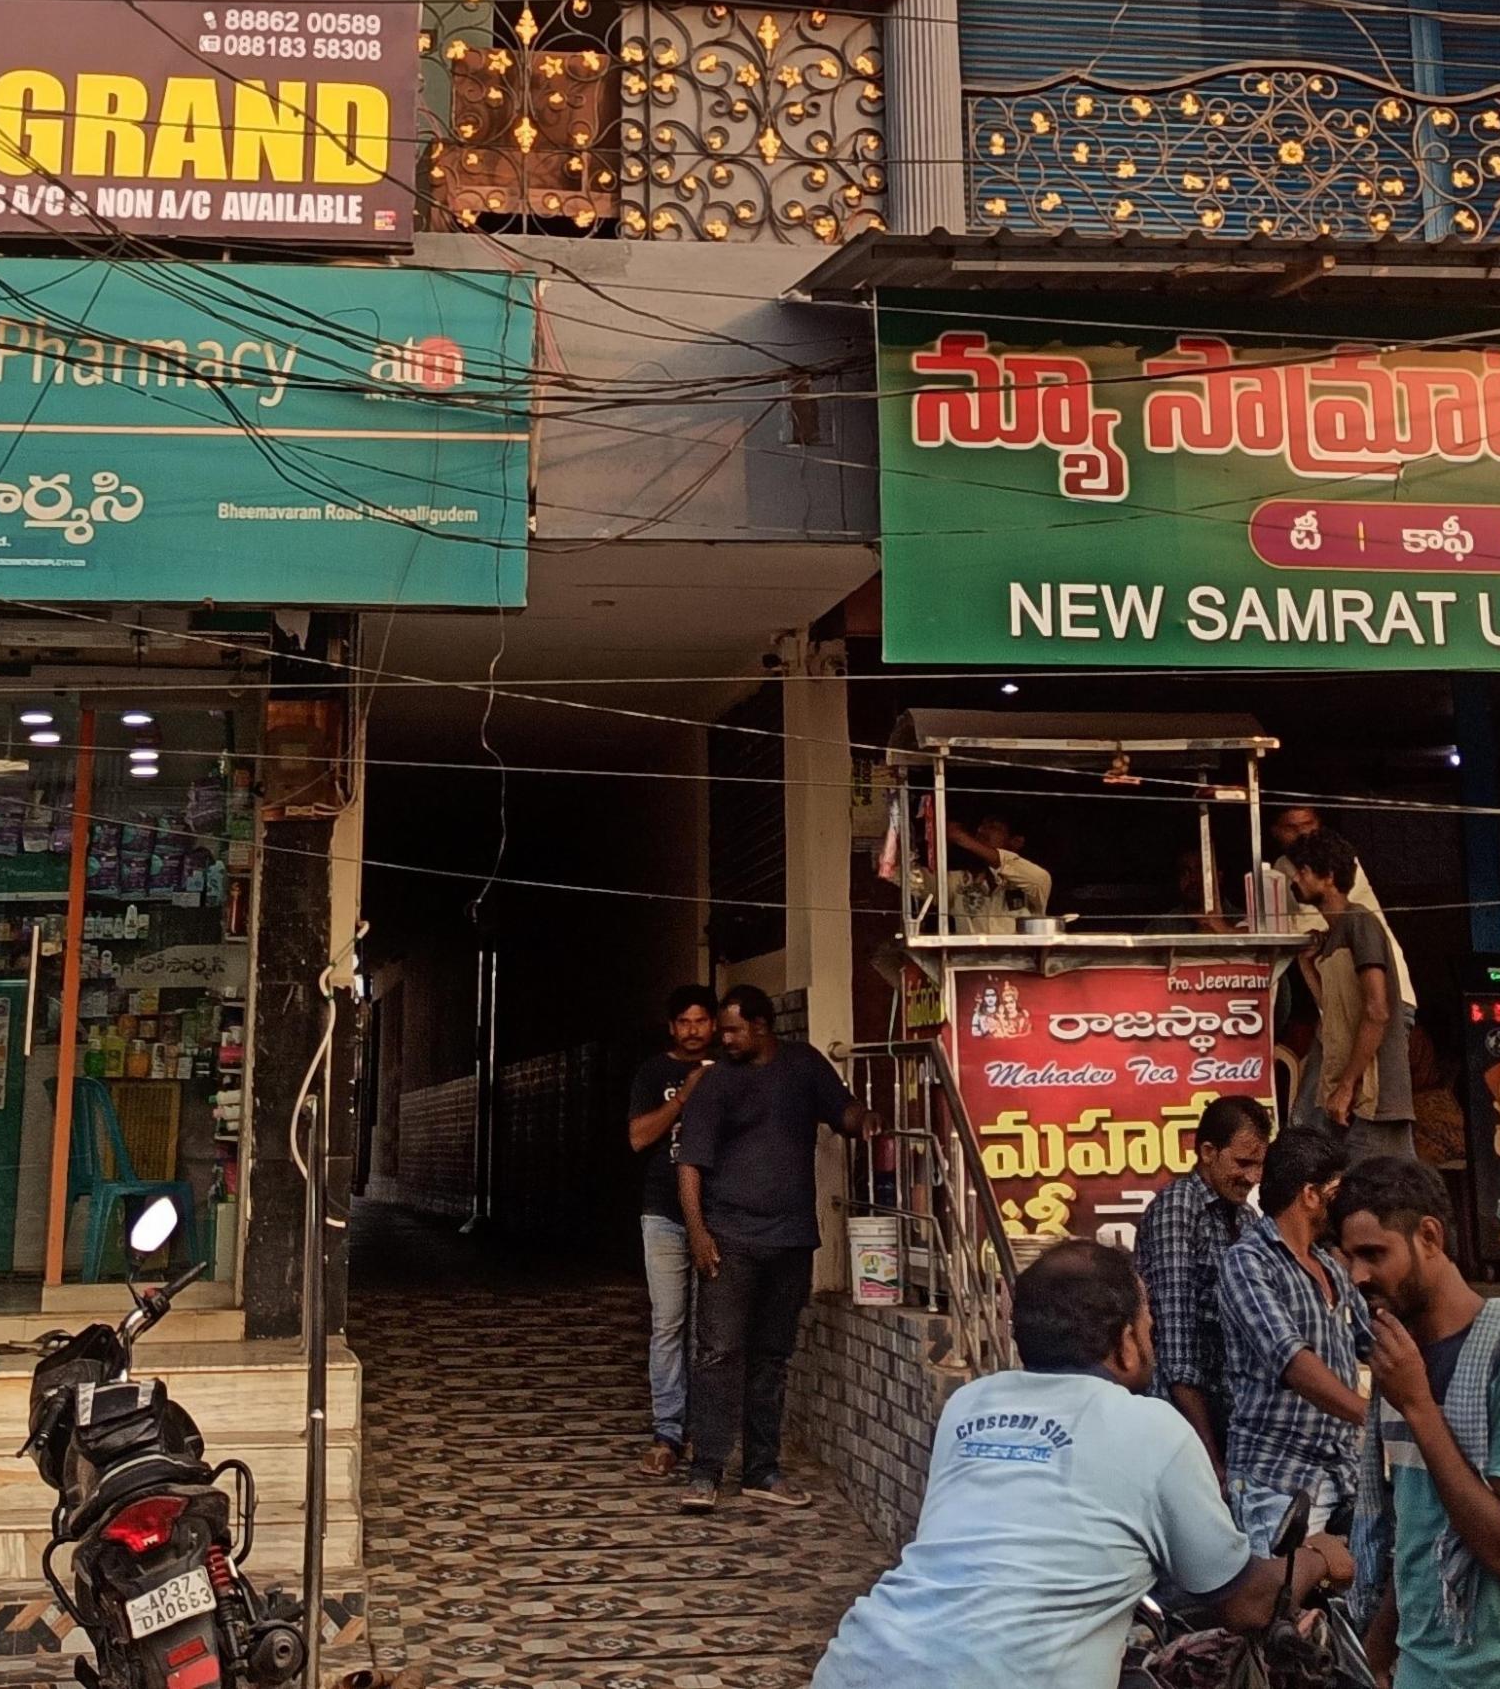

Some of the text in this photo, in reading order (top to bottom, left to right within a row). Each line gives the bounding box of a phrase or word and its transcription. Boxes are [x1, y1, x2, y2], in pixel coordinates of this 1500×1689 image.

[225, 9, 381, 35] 88862 00589
[224, 35, 382, 61] 088183 58308
[97, 187, 154, 220] NON
[158, 188, 212, 222] A/C
[221, 190, 364, 225] AVAILABLE
[912, 330, 1132, 501] న్యూ
[217, 502, 322, 520] Bheemavaram
[325, 503, 363, 520] Road
[1010, 582, 1165, 641] NEW
[1186, 584, 1459, 649] SAMRAT
[984, 1055, 1264, 1089] Mahadev Tea Stall
[956, 1414, 1073, 1449] Crescent Star
[149, 1575, 190, 1611] AP37
